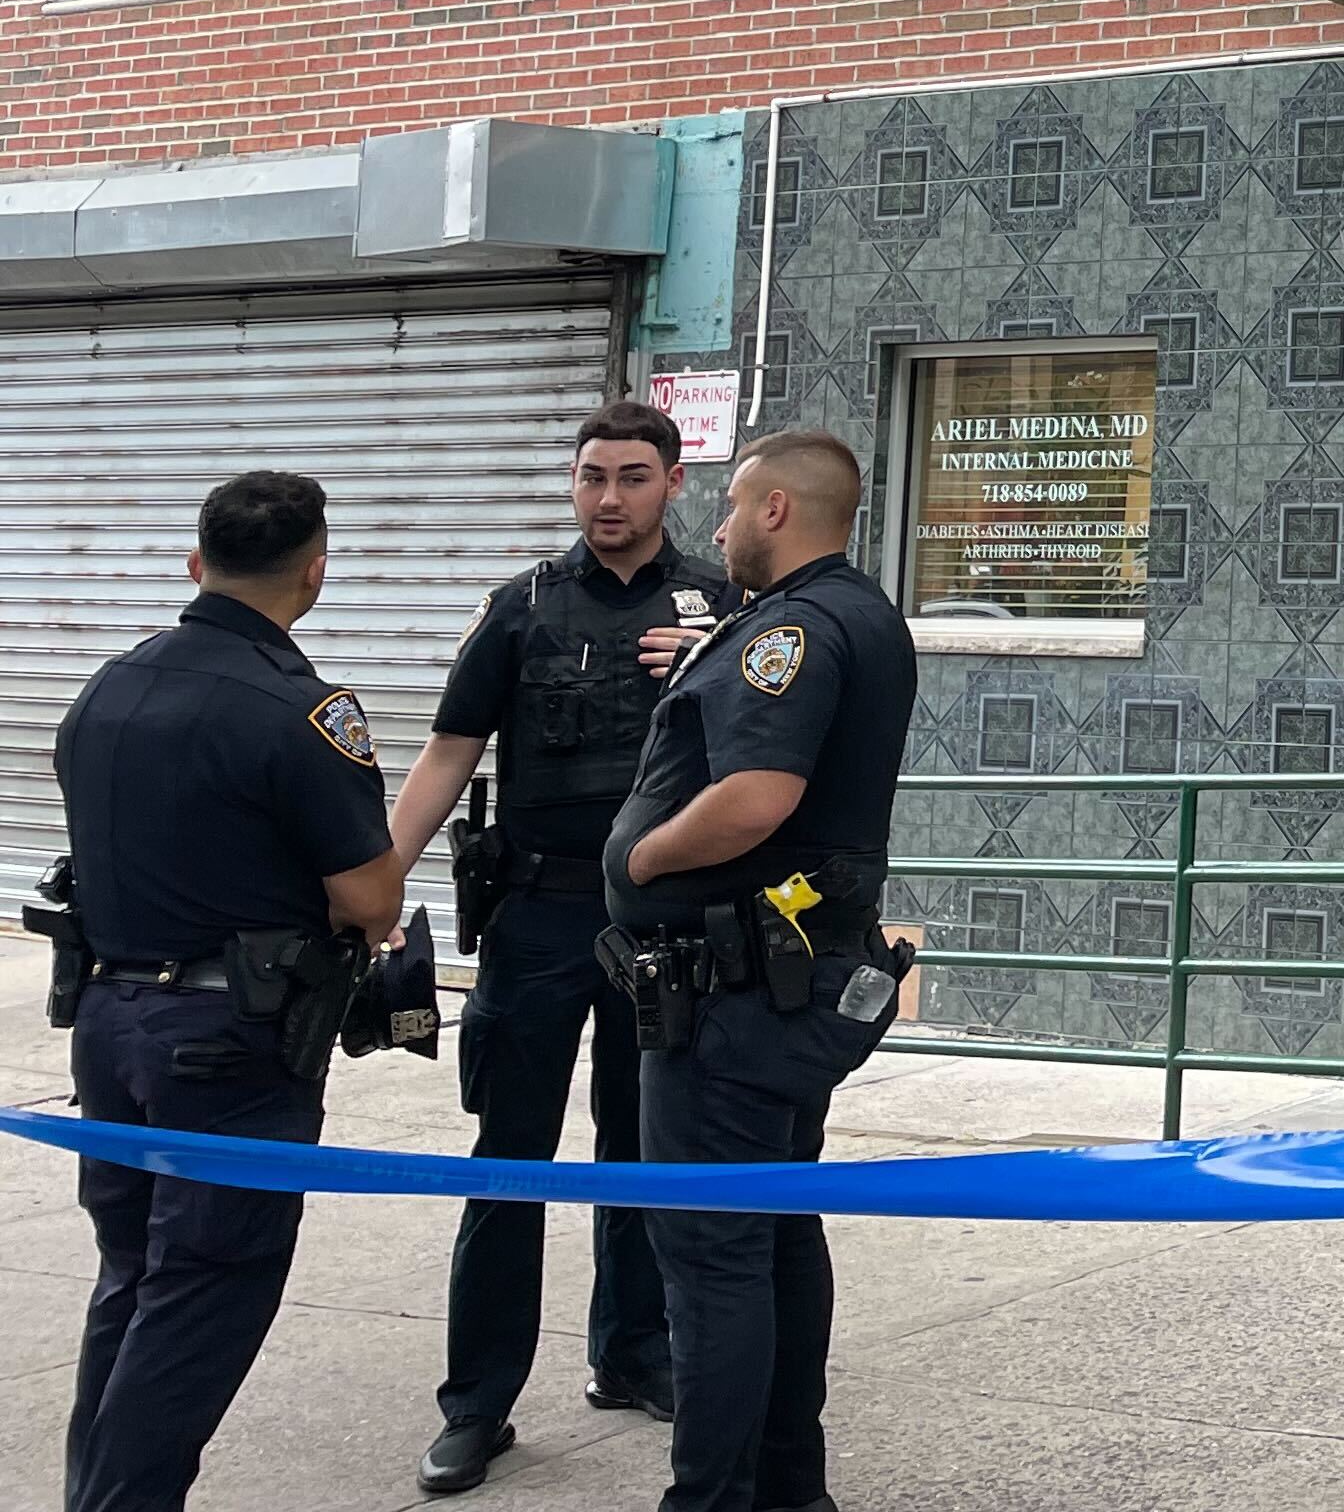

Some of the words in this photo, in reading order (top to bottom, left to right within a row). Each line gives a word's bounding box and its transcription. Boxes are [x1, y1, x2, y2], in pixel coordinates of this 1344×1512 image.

[648, 381, 673, 411] NO
[674, 386, 732, 405] PARKING
[675, 415, 719, 432] YTIME
[931, 419, 1003, 441] ARIEL
[1008, 415, 1105, 439] MEDINA,
[1109, 414, 1148, 437] MD
[941, 452, 1034, 471] INTERNAL
[1038, 449, 1134, 469] MEDICINE
[981, 483, 1088, 503] 718-854-0089
